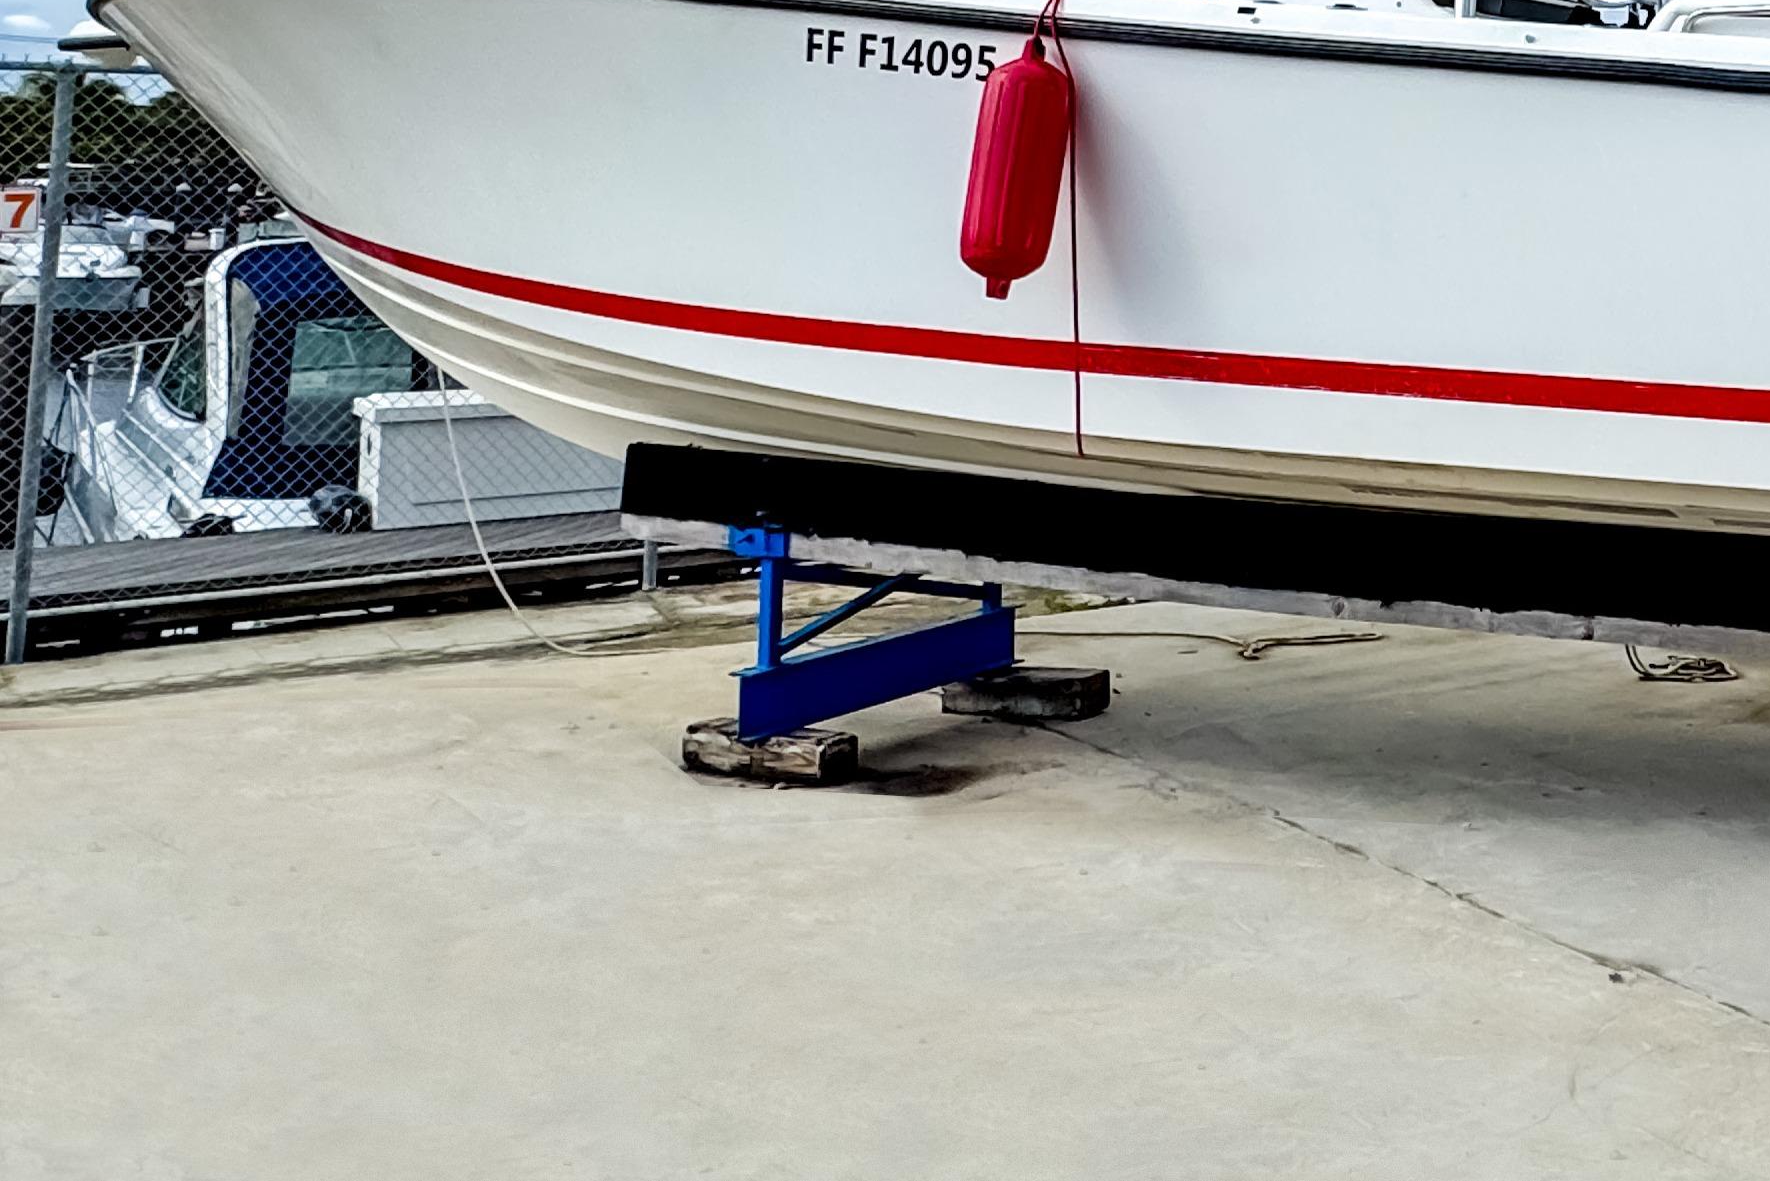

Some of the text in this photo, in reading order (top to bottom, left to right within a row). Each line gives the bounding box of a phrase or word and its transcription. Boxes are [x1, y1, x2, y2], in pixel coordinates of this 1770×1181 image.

[806, 27, 998, 82] FF F14095
[4, 193, 36, 229] 7
